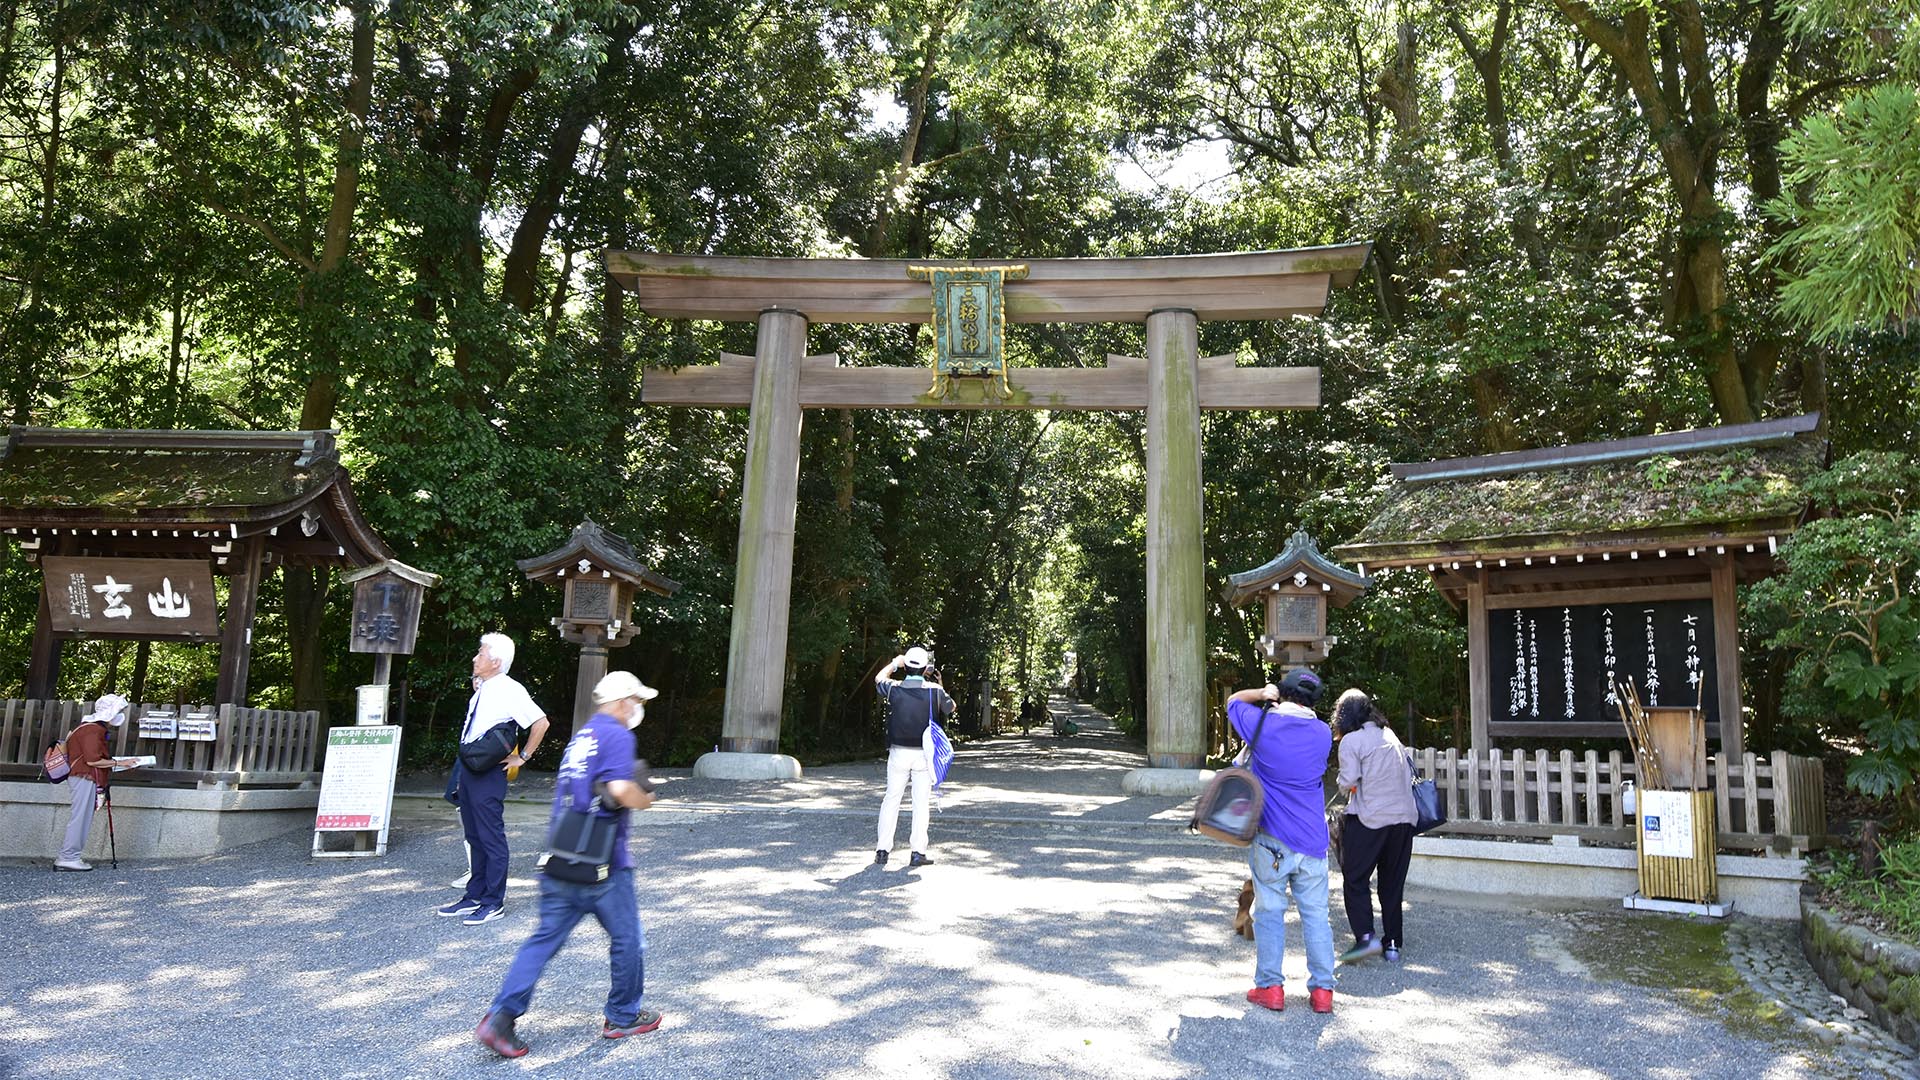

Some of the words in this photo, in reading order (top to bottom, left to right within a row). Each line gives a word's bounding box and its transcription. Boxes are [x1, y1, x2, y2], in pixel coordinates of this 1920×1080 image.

[1683, 614, 1701, 690] 七月の神事
